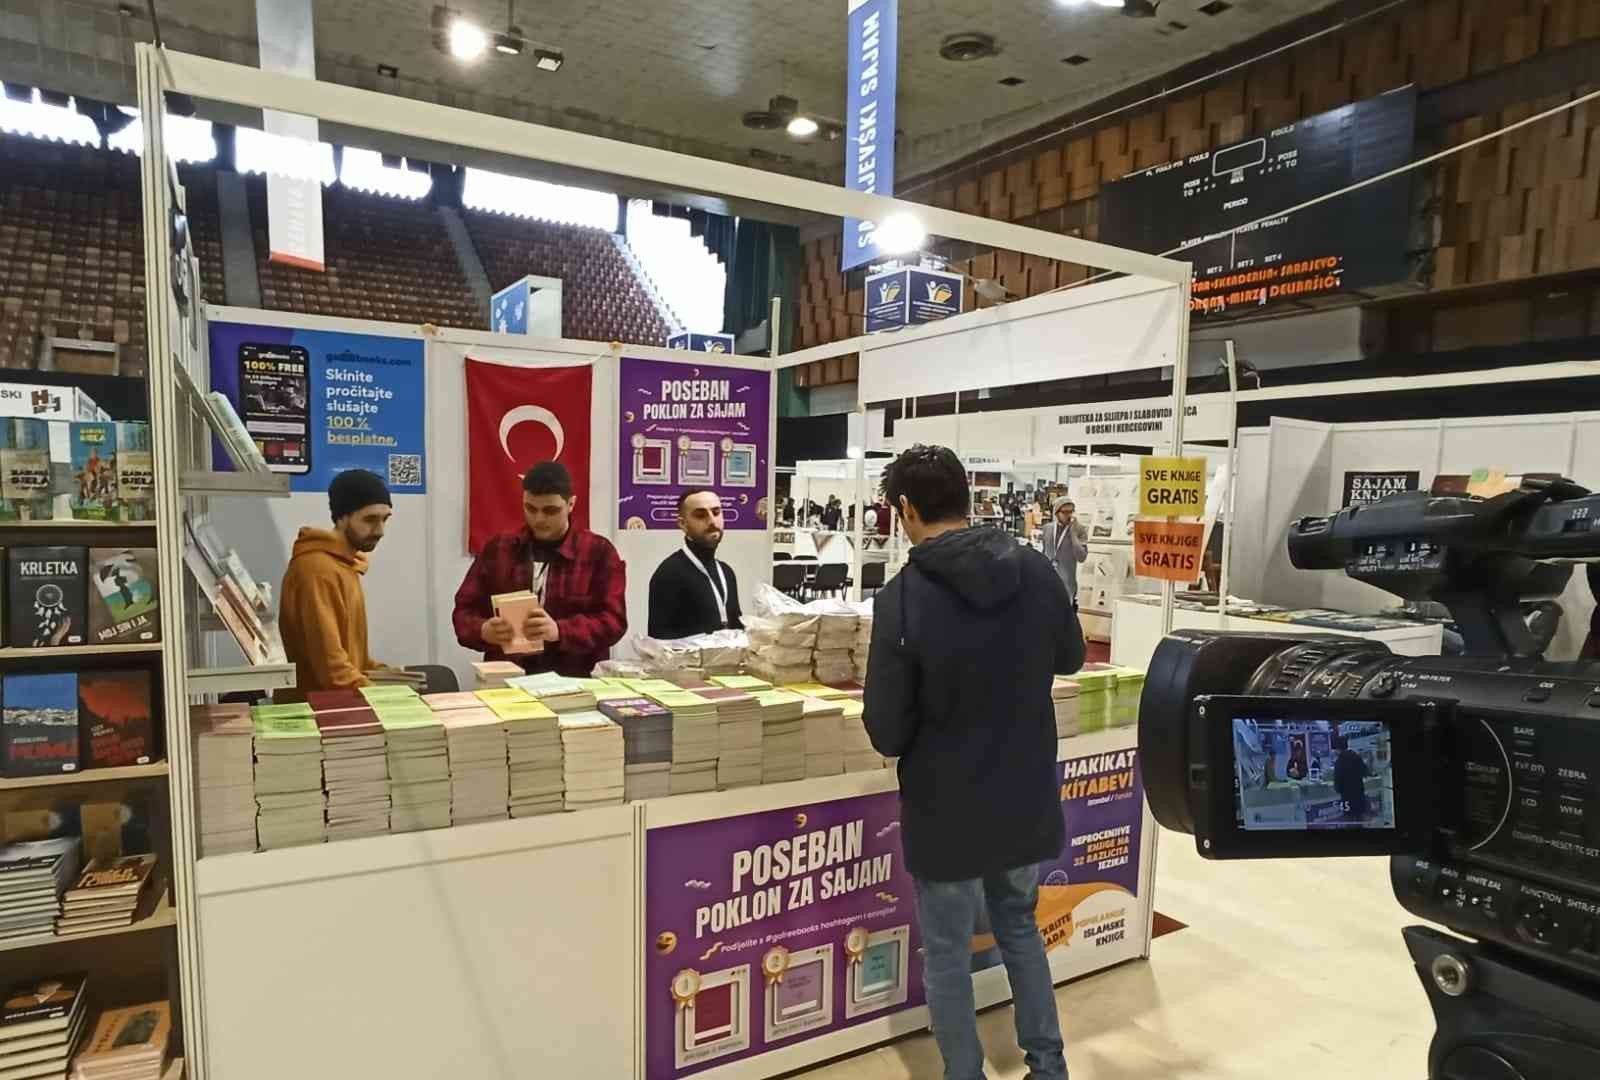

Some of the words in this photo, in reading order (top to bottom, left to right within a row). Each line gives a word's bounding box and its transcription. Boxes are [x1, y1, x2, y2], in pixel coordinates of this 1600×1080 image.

[861, 10, 879, 97] SAJAM
[858, 101, 877, 248] SAJEVSKI
[1223, 198, 1249, 210] PERIOD
[1261, 217, 1288, 228] PENALTY
[278, 363, 304, 373] FREE
[325, 368, 374, 383] Skinite
[326, 385, 393, 402] pročitajte
[661, 380, 730, 402] POSEBAN
[326, 400, 379, 416] slušajte
[643, 403, 688, 420] POKLON
[690, 403, 704, 418] ZA
[707, 402, 746, 418] SAJAM
[1095, 412, 1103, 422] ZA
[1183, 406, 1198, 416] ICA
[1086, 425, 1091, 434] U
[1117, 421, 1163, 433] HERCEGOVINI
[1145, 470, 1168, 481] SVE
[1171, 470, 1201, 482] KNJIGE
[1352, 478, 1407, 489] SAJAM
[1147, 488, 1199, 505] GRATIS
[1351, 489, 1408, 500] KNJI
[1139, 532, 1160, 544] SVE
[1160, 533, 1199, 547] KNJIGE
[20, 561, 78, 576] KRLETKA
[1142, 551, 1195, 570] GRATIS
[1513, 726, 1535, 736] BARS
[1558, 767, 1588, 780] ZEBRA
[732, 819, 864, 892] POSEBAN
[696, 885, 782, 939] POKLON
[788, 877, 814, 911] ZA
[820, 853, 892, 901] SAJAM
[1521, 885, 1562, 904] FUNCTION
[1084, 918, 1125, 939] ISLAMSKE
[1096, 930, 1125, 947] KNJIGE
